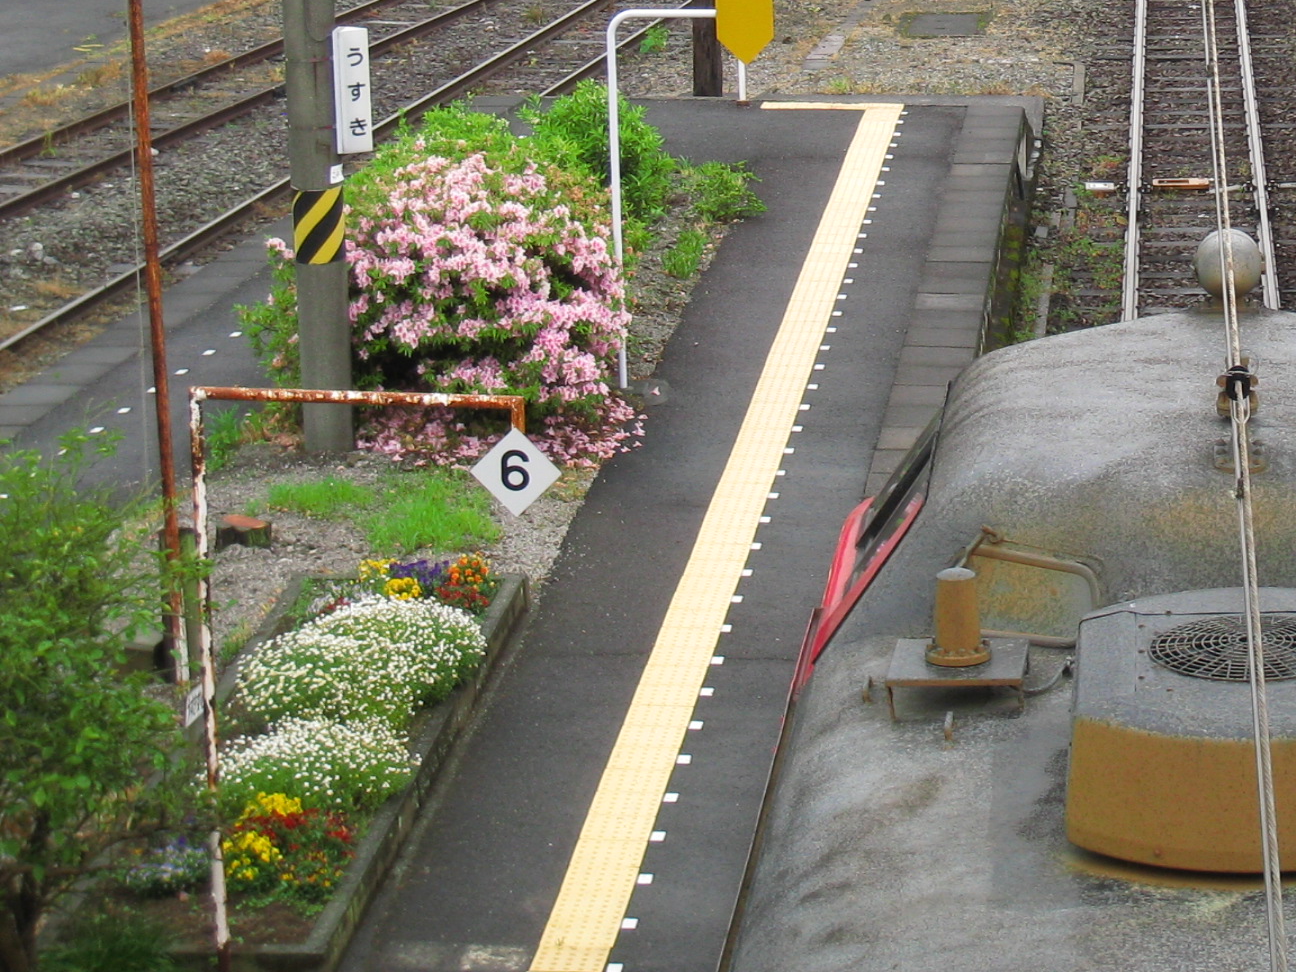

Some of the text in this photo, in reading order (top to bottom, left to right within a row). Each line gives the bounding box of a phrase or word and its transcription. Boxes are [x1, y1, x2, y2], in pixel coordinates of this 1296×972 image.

[347, 47, 368, 137] うすき
[501, 449, 530, 492] 6
